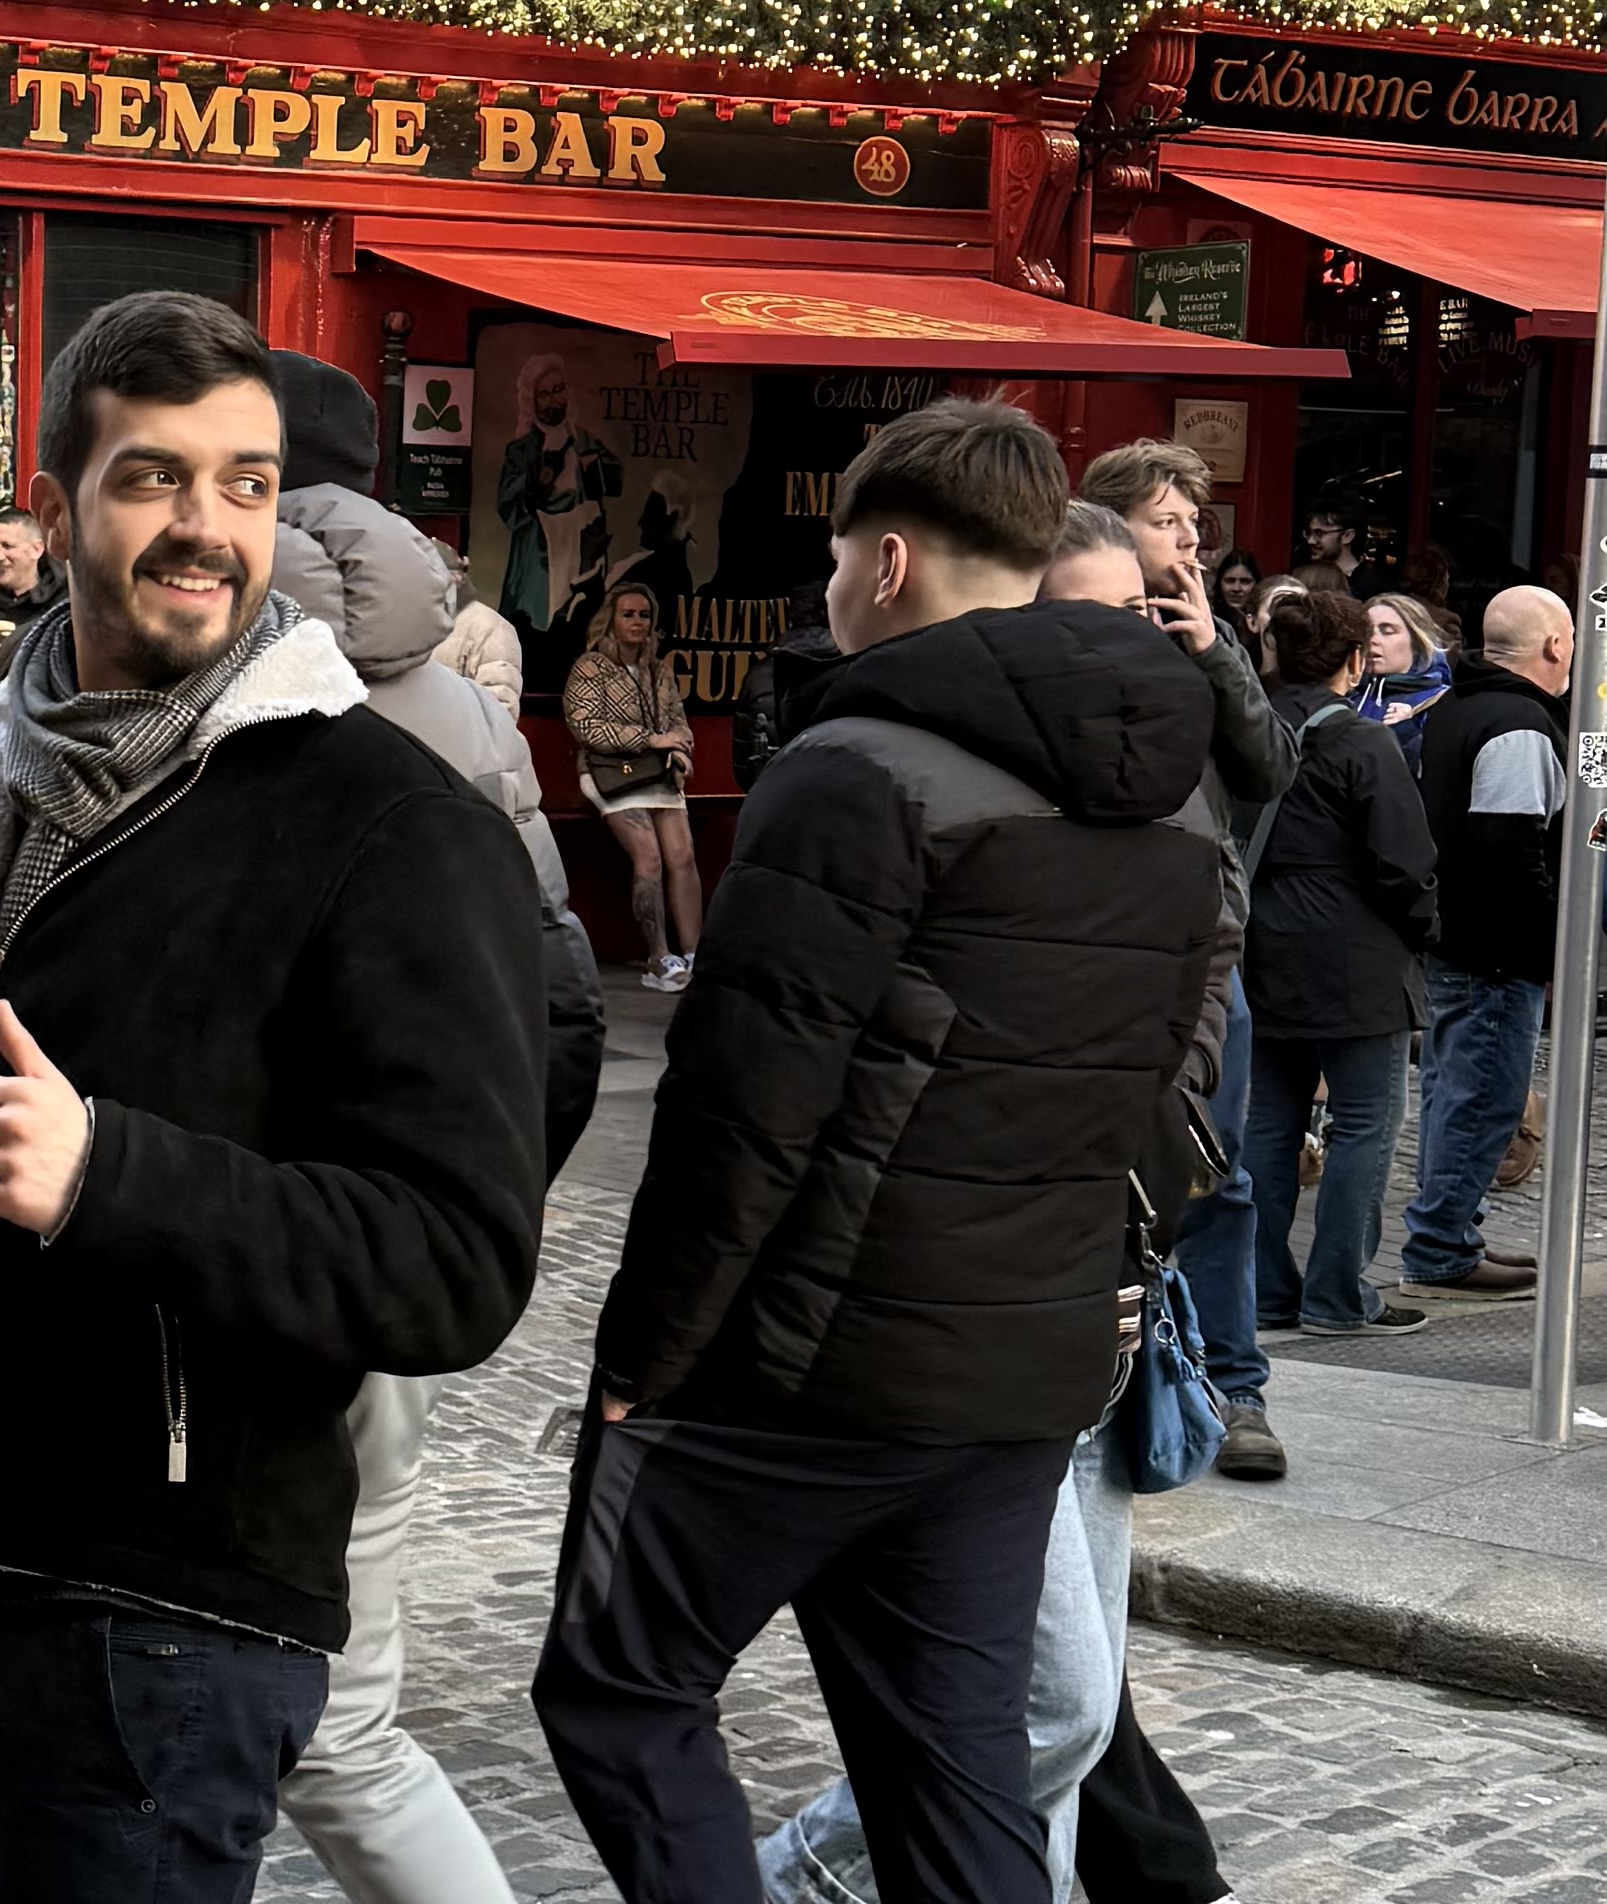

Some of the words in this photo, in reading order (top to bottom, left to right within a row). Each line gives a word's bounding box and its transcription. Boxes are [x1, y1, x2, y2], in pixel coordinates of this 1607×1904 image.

[11, 69, 431, 170] TEMPLE
[474, 104, 668, 187] BAR
[861, 147, 897, 183] 48
[599, 387, 730, 427] TEMPLE
[630, 423, 699, 462] BAR
